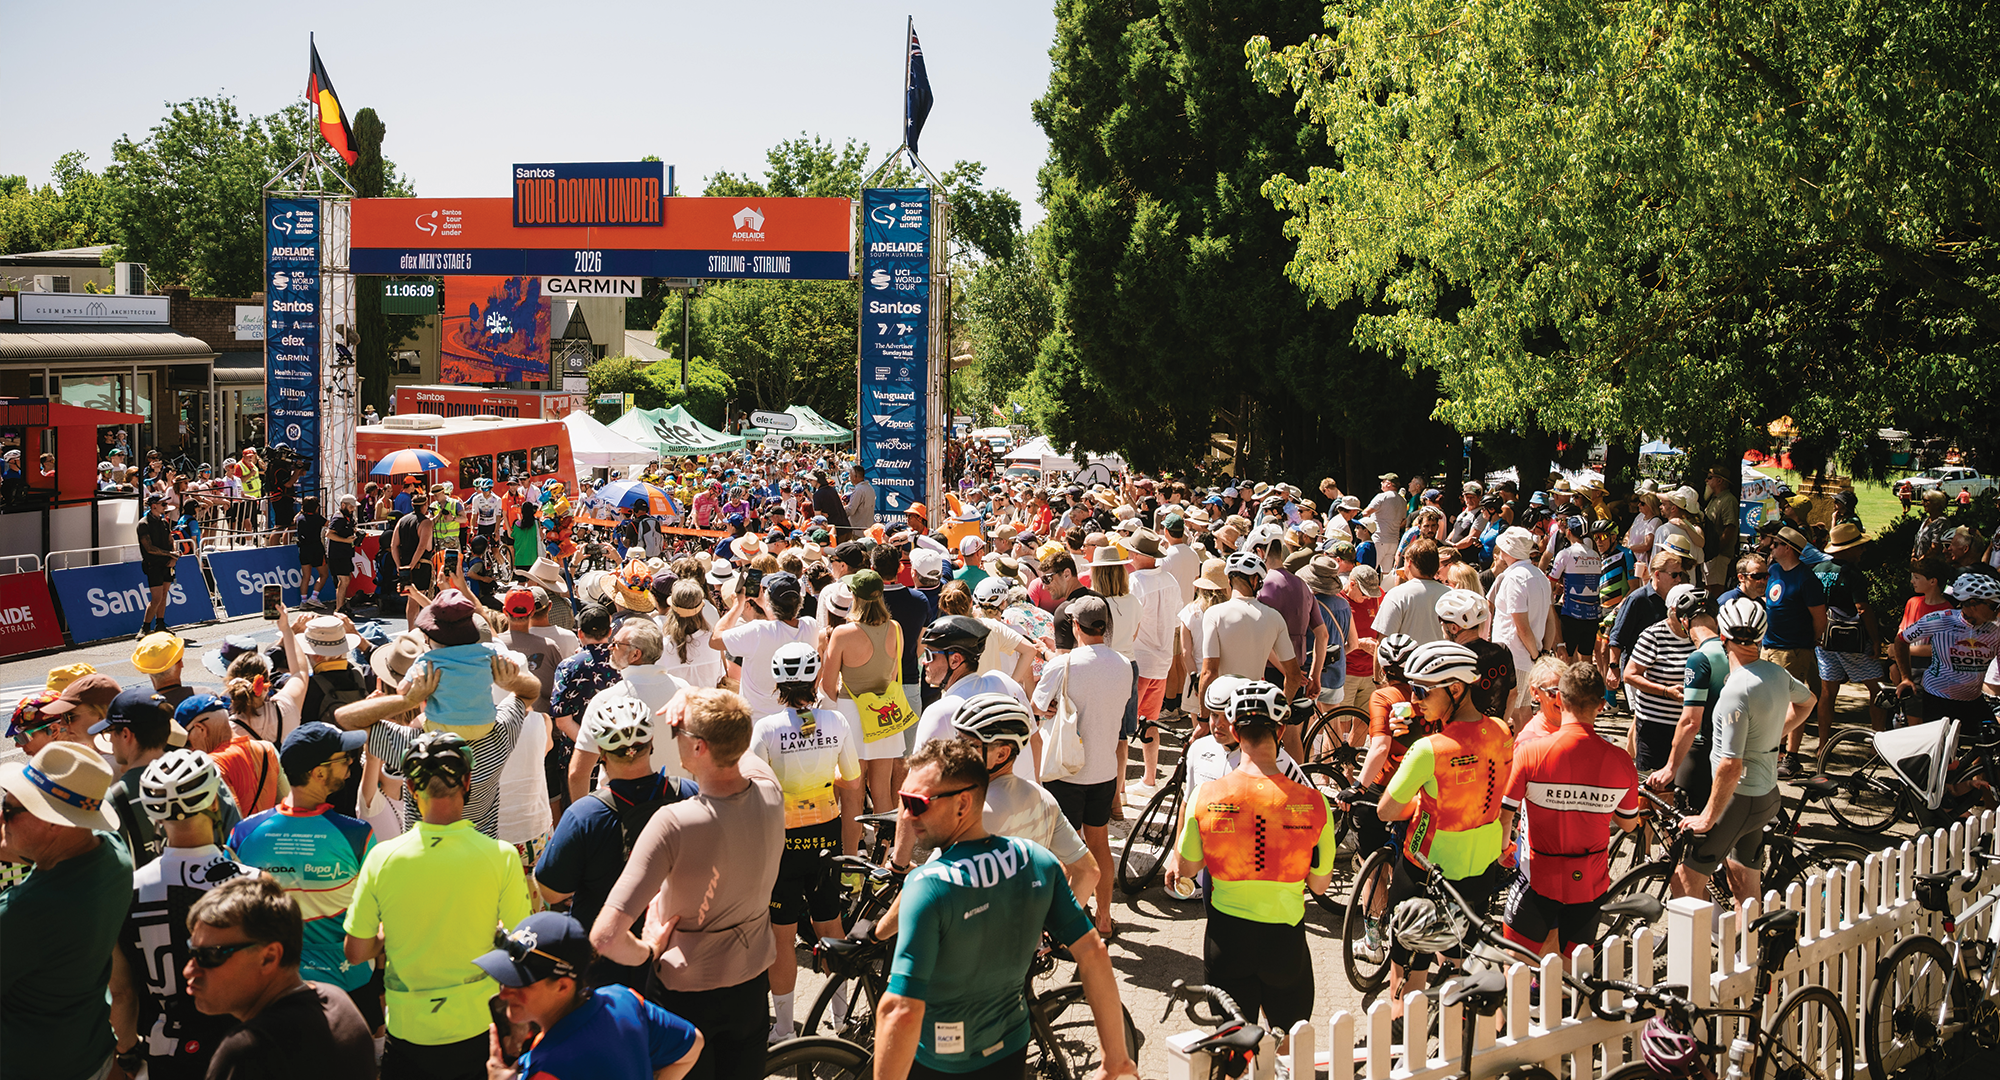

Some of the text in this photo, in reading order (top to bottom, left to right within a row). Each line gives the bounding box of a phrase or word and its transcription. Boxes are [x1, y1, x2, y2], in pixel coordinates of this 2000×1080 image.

[516, 168, 555, 178] Santos
[516, 177, 660, 224] TOUR DOWN UNDER
[272, 247, 314, 256] ADELAIDE
[870, 242, 923, 252] ADELAIDE
[400, 254, 472, 270] efex MEN'S STAGE 5
[574, 251, 602, 272] 2026
[708, 256, 746, 272] STIRLING
[753, 256, 790, 273] STIRLING
[385, 284, 434, 296] 11:06:09
[547, 278, 635, 294] GARMIN
[272, 300, 314, 312] Santos
[870, 301, 922, 314] Santos
[282, 334, 305, 346] efex
[276, 354, 310, 362] GARMIN
[570, 358, 582, 366] 85
[280, 387, 306, 397] Hilton
[416, 392, 445, 401] Santos
[872, 390, 915, 402] Vanguard
[28, 404, 48, 425] UNDER
[874, 458, 912, 469] Santini
[872, 478, 914, 486] SHIMANO
[882, 514, 908, 523] YAMAH
[86, 581, 187, 618] Sants
[1906, 628, 1923, 642] BOSS
[780, 729, 822, 741] HONS
[780, 736, 838, 750] LAWYERS
[1546, 788, 1616, 802] REDLANDS
[1418, 812, 1429, 833] BLACK
[430, 836, 443, 848] 7
[786, 840, 836, 850] LAWYERS
[304, 864, 332, 874] Bupa
[430, 997, 448, 1014] 7
